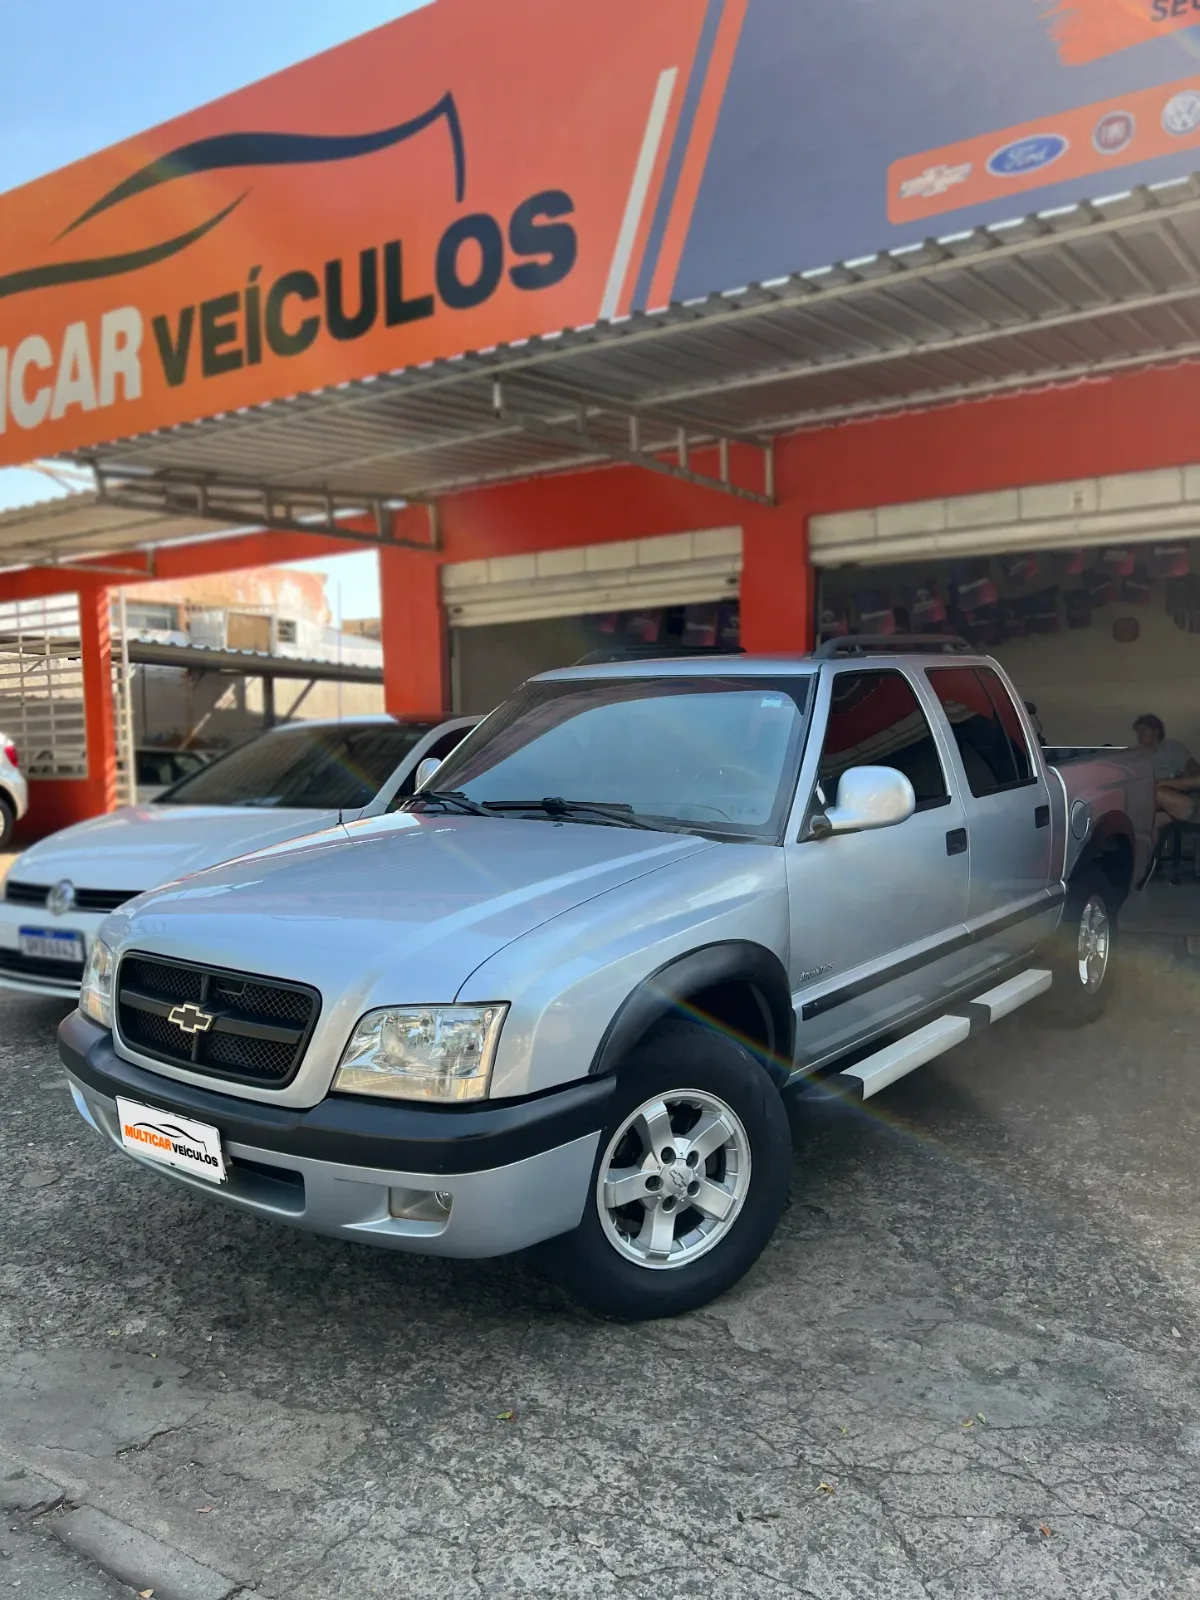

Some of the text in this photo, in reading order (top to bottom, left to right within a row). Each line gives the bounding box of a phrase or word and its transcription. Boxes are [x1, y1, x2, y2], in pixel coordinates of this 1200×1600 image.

[151, 189, 578, 388] VEÍCULOS
[125, 1125, 219, 1167] MULTICAR VEÍCULOS
